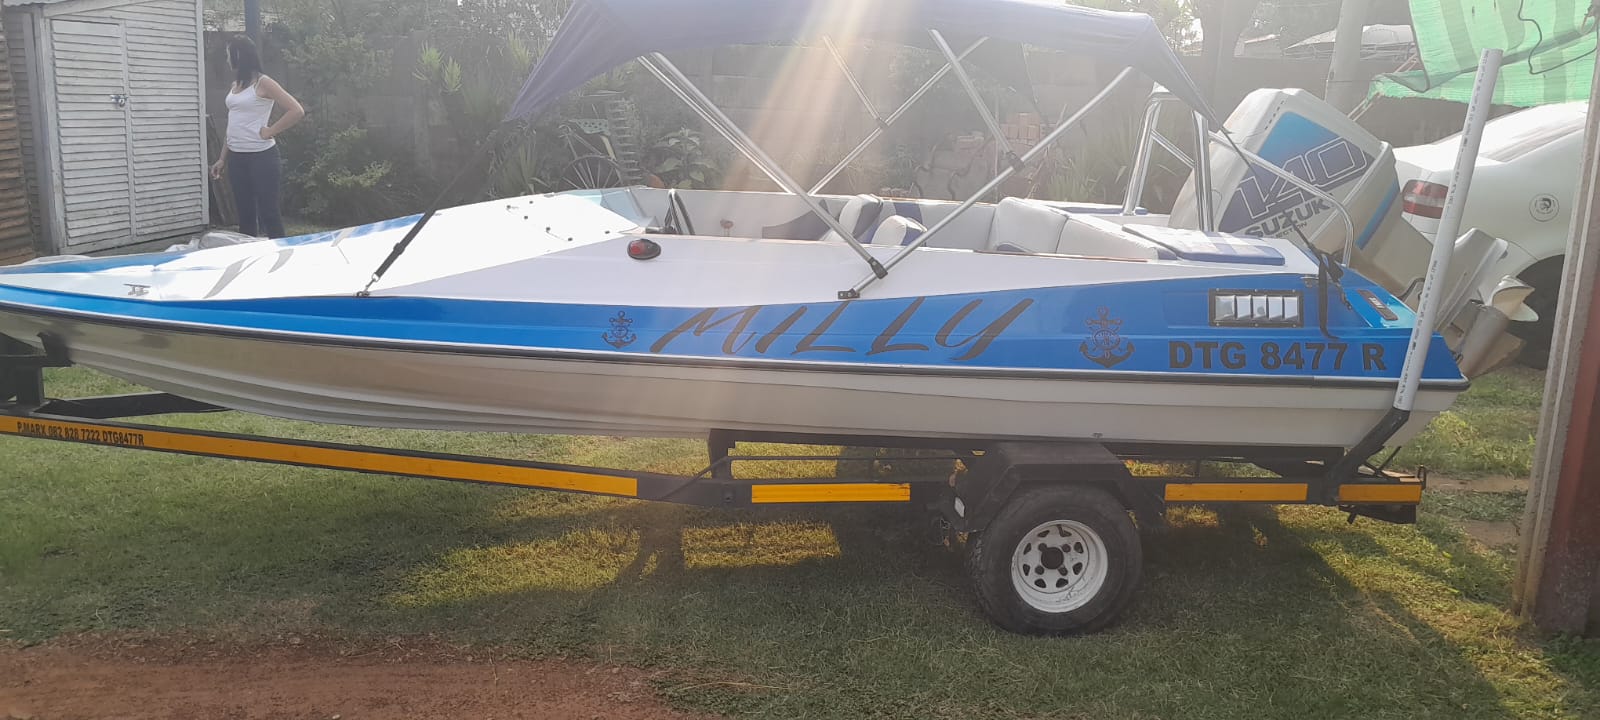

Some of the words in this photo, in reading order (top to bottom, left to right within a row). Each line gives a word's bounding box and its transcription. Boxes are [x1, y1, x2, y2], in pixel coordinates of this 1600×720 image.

[1236, 136, 1368, 219] 140
[1244, 198, 1334, 238] SUZUK
[649, 296, 1035, 361] MILLY
[1168, 341, 1247, 370] DTG
[1261, 342, 1348, 370] 8477
[1362, 343, 1387, 371] R
[81, 428, 101, 441] 7222
[102, 430, 145, 446] DTG8477R
